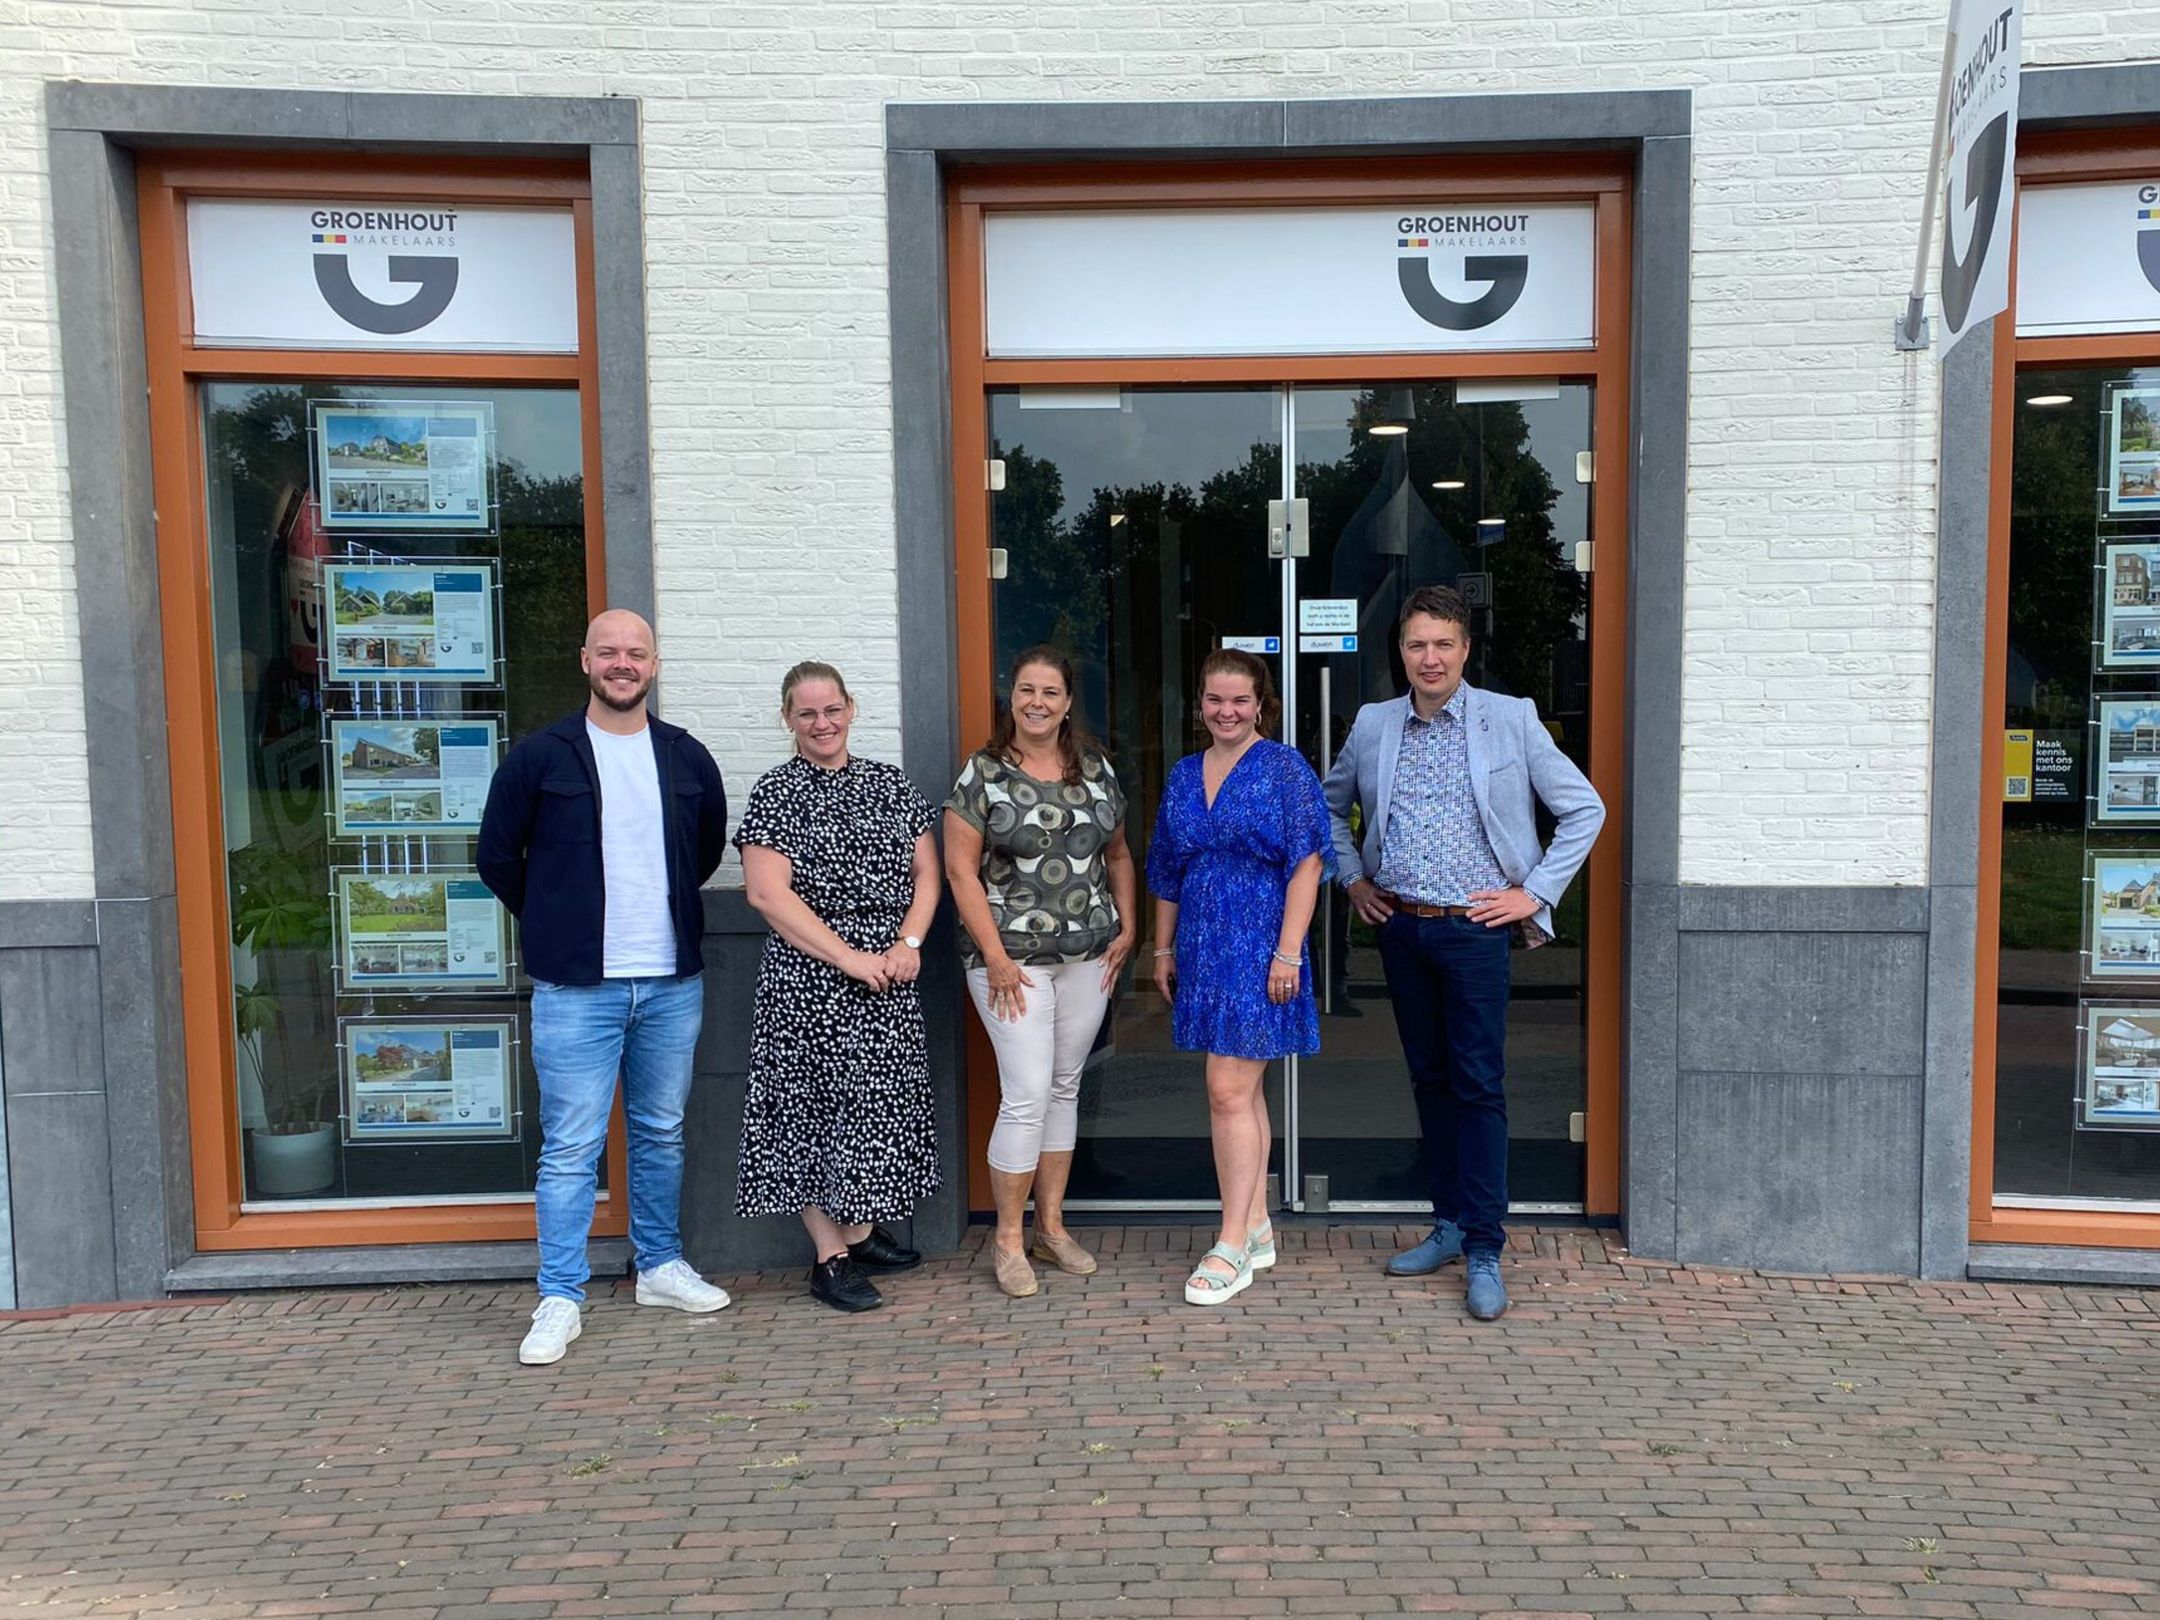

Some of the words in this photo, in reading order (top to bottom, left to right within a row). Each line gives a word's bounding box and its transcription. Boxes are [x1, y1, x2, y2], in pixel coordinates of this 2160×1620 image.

[311, 211, 457, 231] GROENHOUT
[1398, 215, 1529, 234] GROENHOUT
[353, 235, 456, 247] MAKELAARS
[1435, 236, 1527, 247] MAKELAARS
[2036, 740, 2062, 748] Maak
[2036, 748, 2067, 756] kennis
[2035, 764, 2072, 772] kantoor
